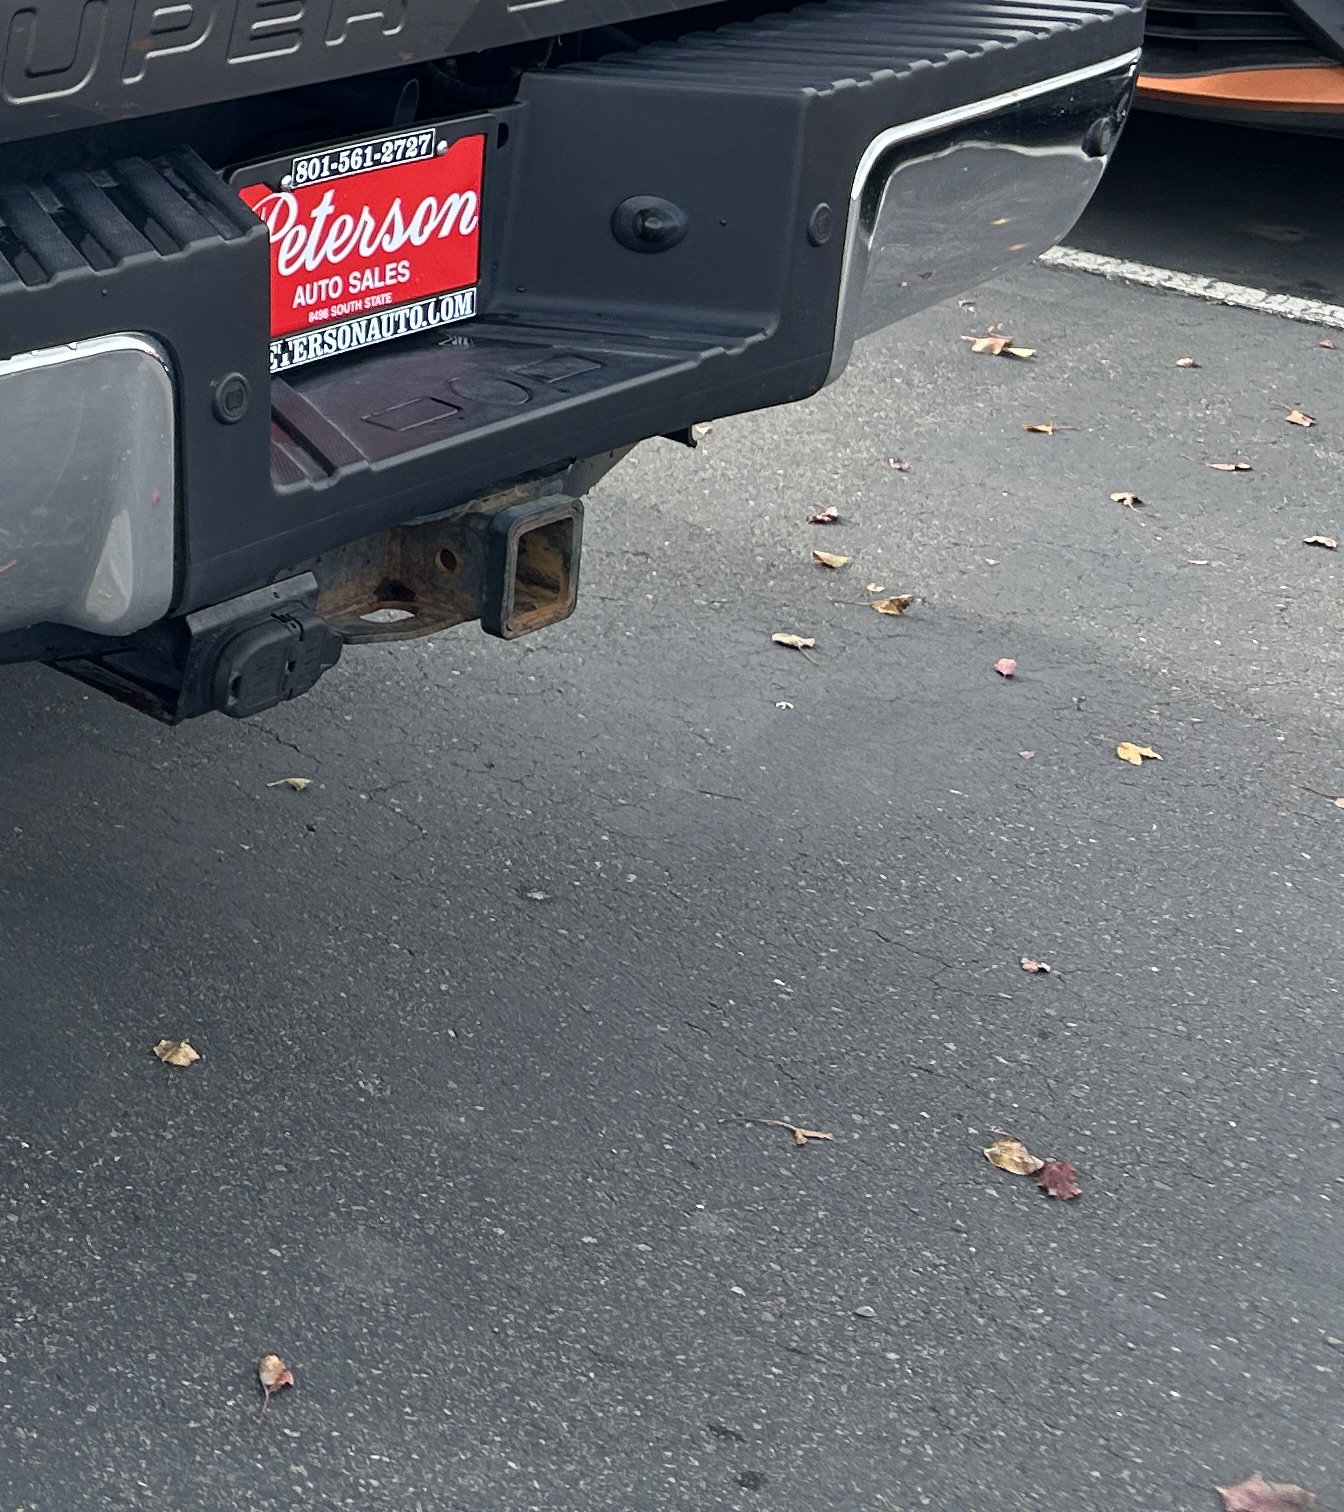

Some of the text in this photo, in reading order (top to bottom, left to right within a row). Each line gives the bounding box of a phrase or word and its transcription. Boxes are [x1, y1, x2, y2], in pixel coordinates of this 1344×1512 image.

[296, 134, 431, 183] 801-561-2727
[252, 188, 479, 277] Peterson
[292, 260, 411, 309] AUTO SALES
[330, 299, 363, 317] SOUTH
[364, 292, 393, 309] STATE
[270, 295, 474, 370] ETERSONAUTO.COM
